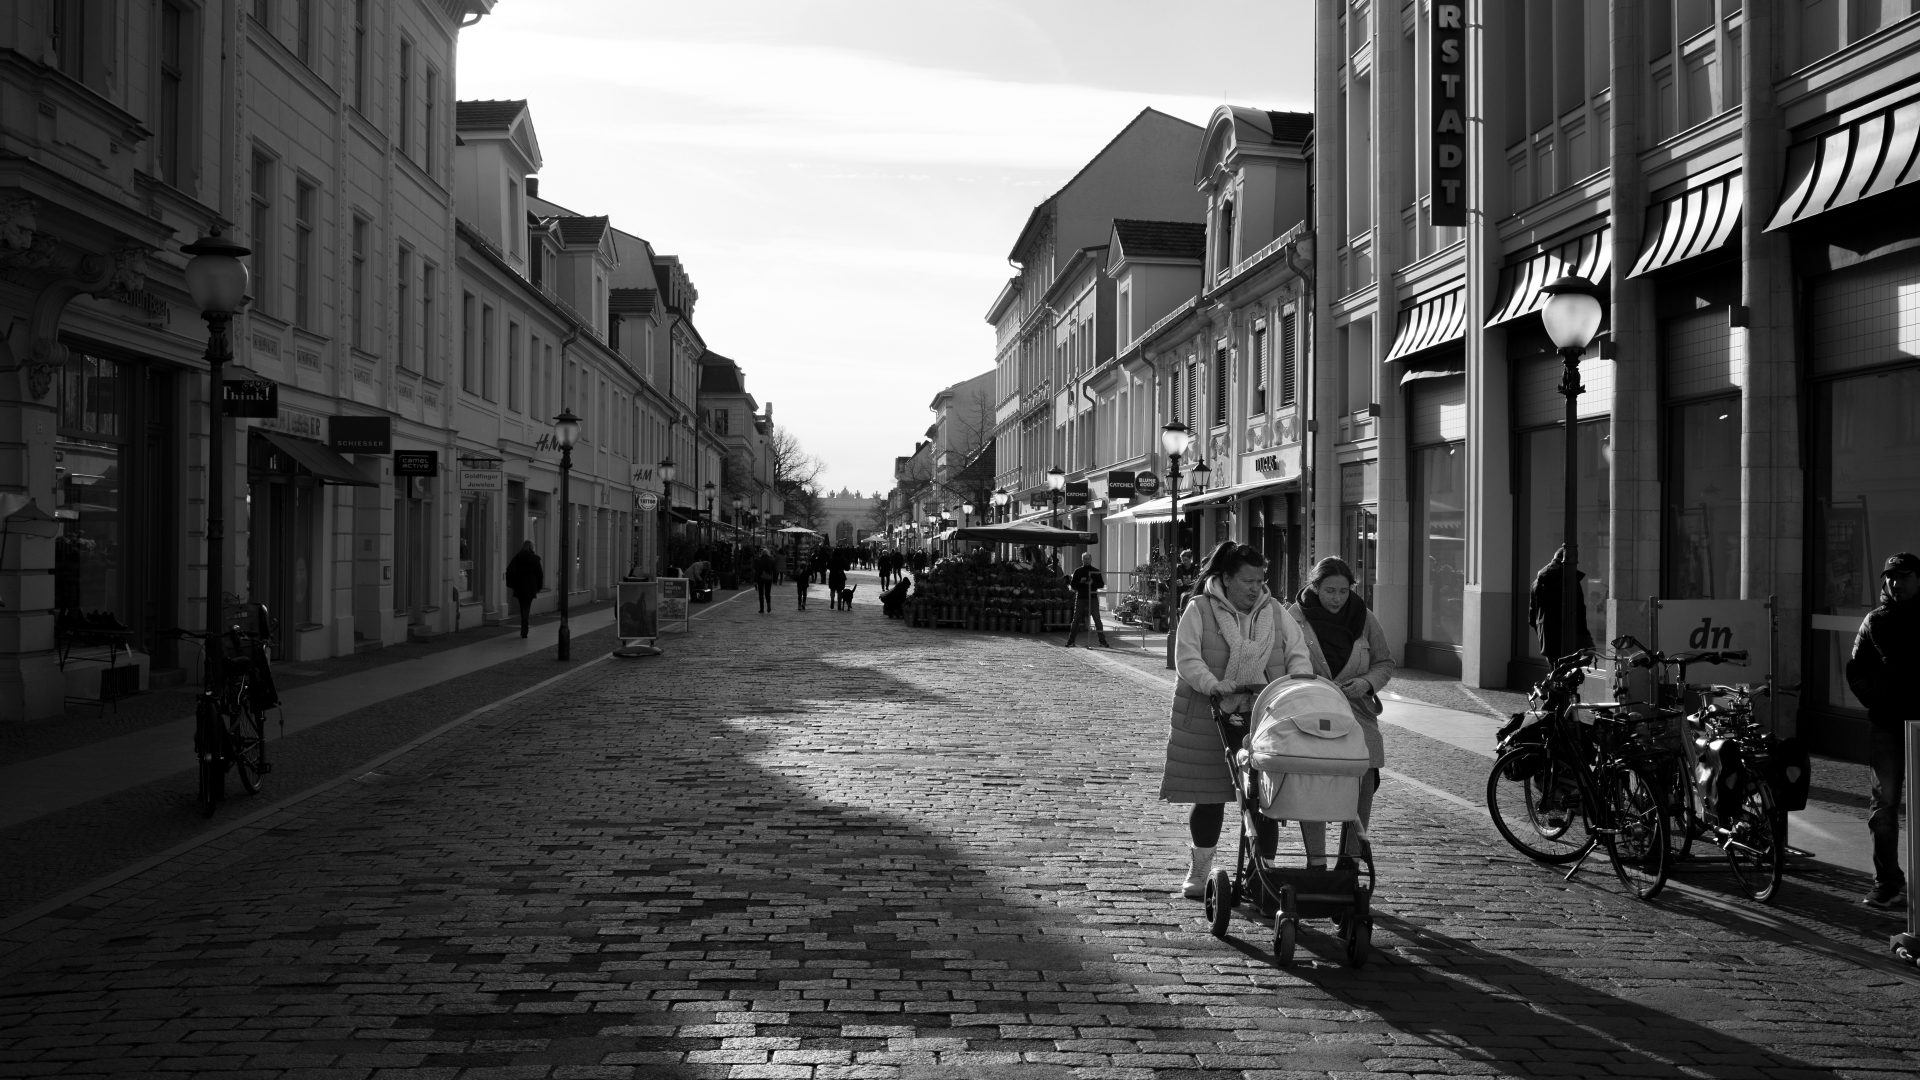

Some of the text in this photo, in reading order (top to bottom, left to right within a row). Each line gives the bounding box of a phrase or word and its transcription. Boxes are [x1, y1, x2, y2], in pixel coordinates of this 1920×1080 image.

[1437, 4, 1464, 204] RSTADT
[223, 386, 270, 401] Think!
[336, 440, 384, 448] SCHIESSER
[633, 469, 652, 482] H&M
